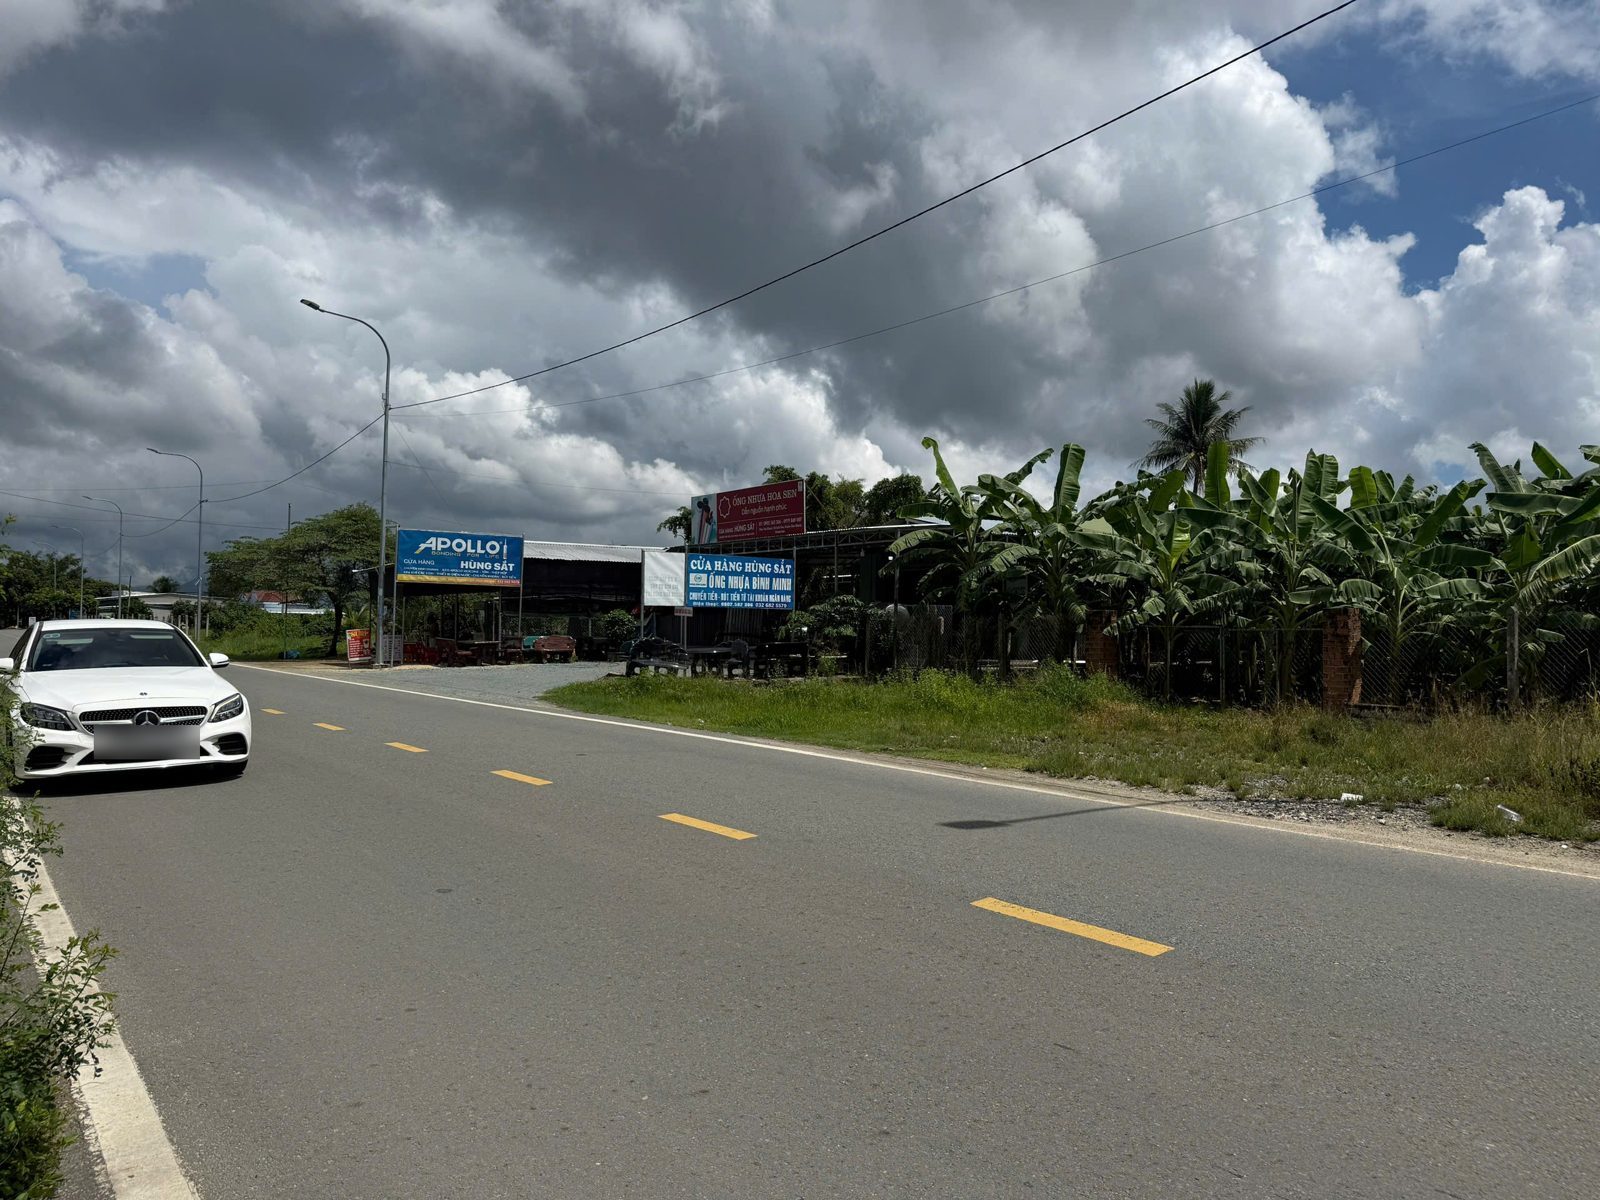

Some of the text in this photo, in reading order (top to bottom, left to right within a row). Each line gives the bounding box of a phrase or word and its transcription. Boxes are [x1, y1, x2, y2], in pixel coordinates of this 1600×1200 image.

[767, 491, 782, 500] HOA
[783, 489, 797, 498] SEN
[414, 536, 500, 554] APOLLO
[460, 560, 515, 571] HÙNG SẮT
[690, 556, 792, 574] CỬA HÀNG HÙNG SẮT
[709, 572, 792, 592] ỐNG NHỰA BÌNH MINH
